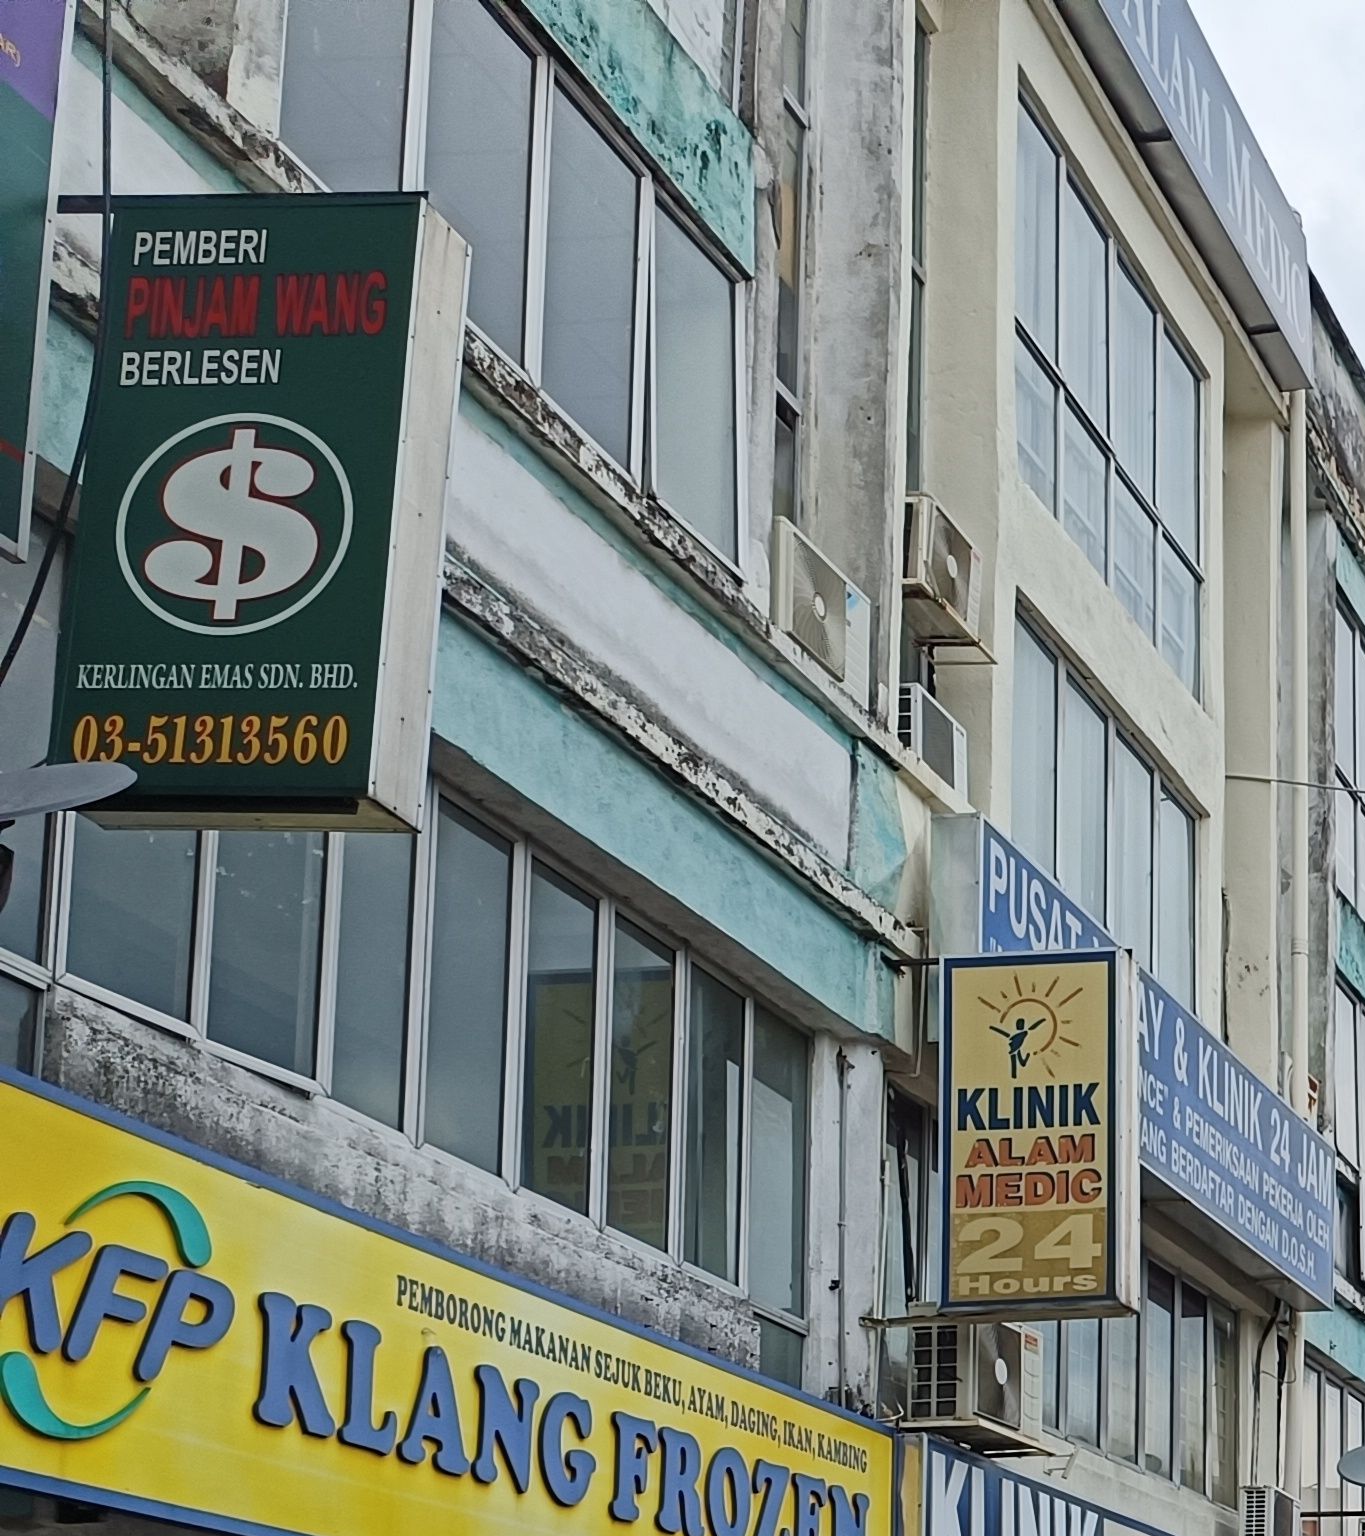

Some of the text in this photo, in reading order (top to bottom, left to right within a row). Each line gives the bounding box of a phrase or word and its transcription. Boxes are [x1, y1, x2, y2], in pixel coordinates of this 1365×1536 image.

[133, 228, 267, 266] PEMBERI
[1223, 103, 1307, 343] MEDIC
[125, 270, 388, 339] PINJAM WANG
[119, 348, 281, 387] BERLESEN
[77, 663, 358, 690] KERLINGAN EMAS SDN. BHD.
[73, 714, 349, 765] 03-51313560
[989, 837, 1082, 950] PUSAT
[957, 1082, 1102, 1131] KLINIK
[1173, 1017, 1189, 1087] &
[1198, 1036, 1264, 1152] KLINIK
[1270, 1107, 1292, 1174] 24
[1298, 1132, 1333, 1212] JAM
[965, 1133, 1096, 1168] ALAM
[1173, 1096, 1182, 1130] &
[1185, 1105, 1259, 1195] PEMERIKSAAN
[1262, 1171, 1304, 1229] PEKERJA
[1307, 1210, 1330, 1251] OLEH
[955, 1168, 1103, 1209] MEDIC
[1171, 1139, 1235, 1218] BERDAFTAR
[1238, 1198, 1279, 1252] DENGAN
[957, 1214, 1103, 1274] 24
[0, 1211, 235, 1382] KFP
[957, 1272, 1098, 1297] Hours
[253, 1290, 598, 1508] KLANG
[396, 1274, 868, 1474] PEMBORONG MAKANAN SEJUK BEKU, AYAM, DAGING, IKAN, KAMBING
